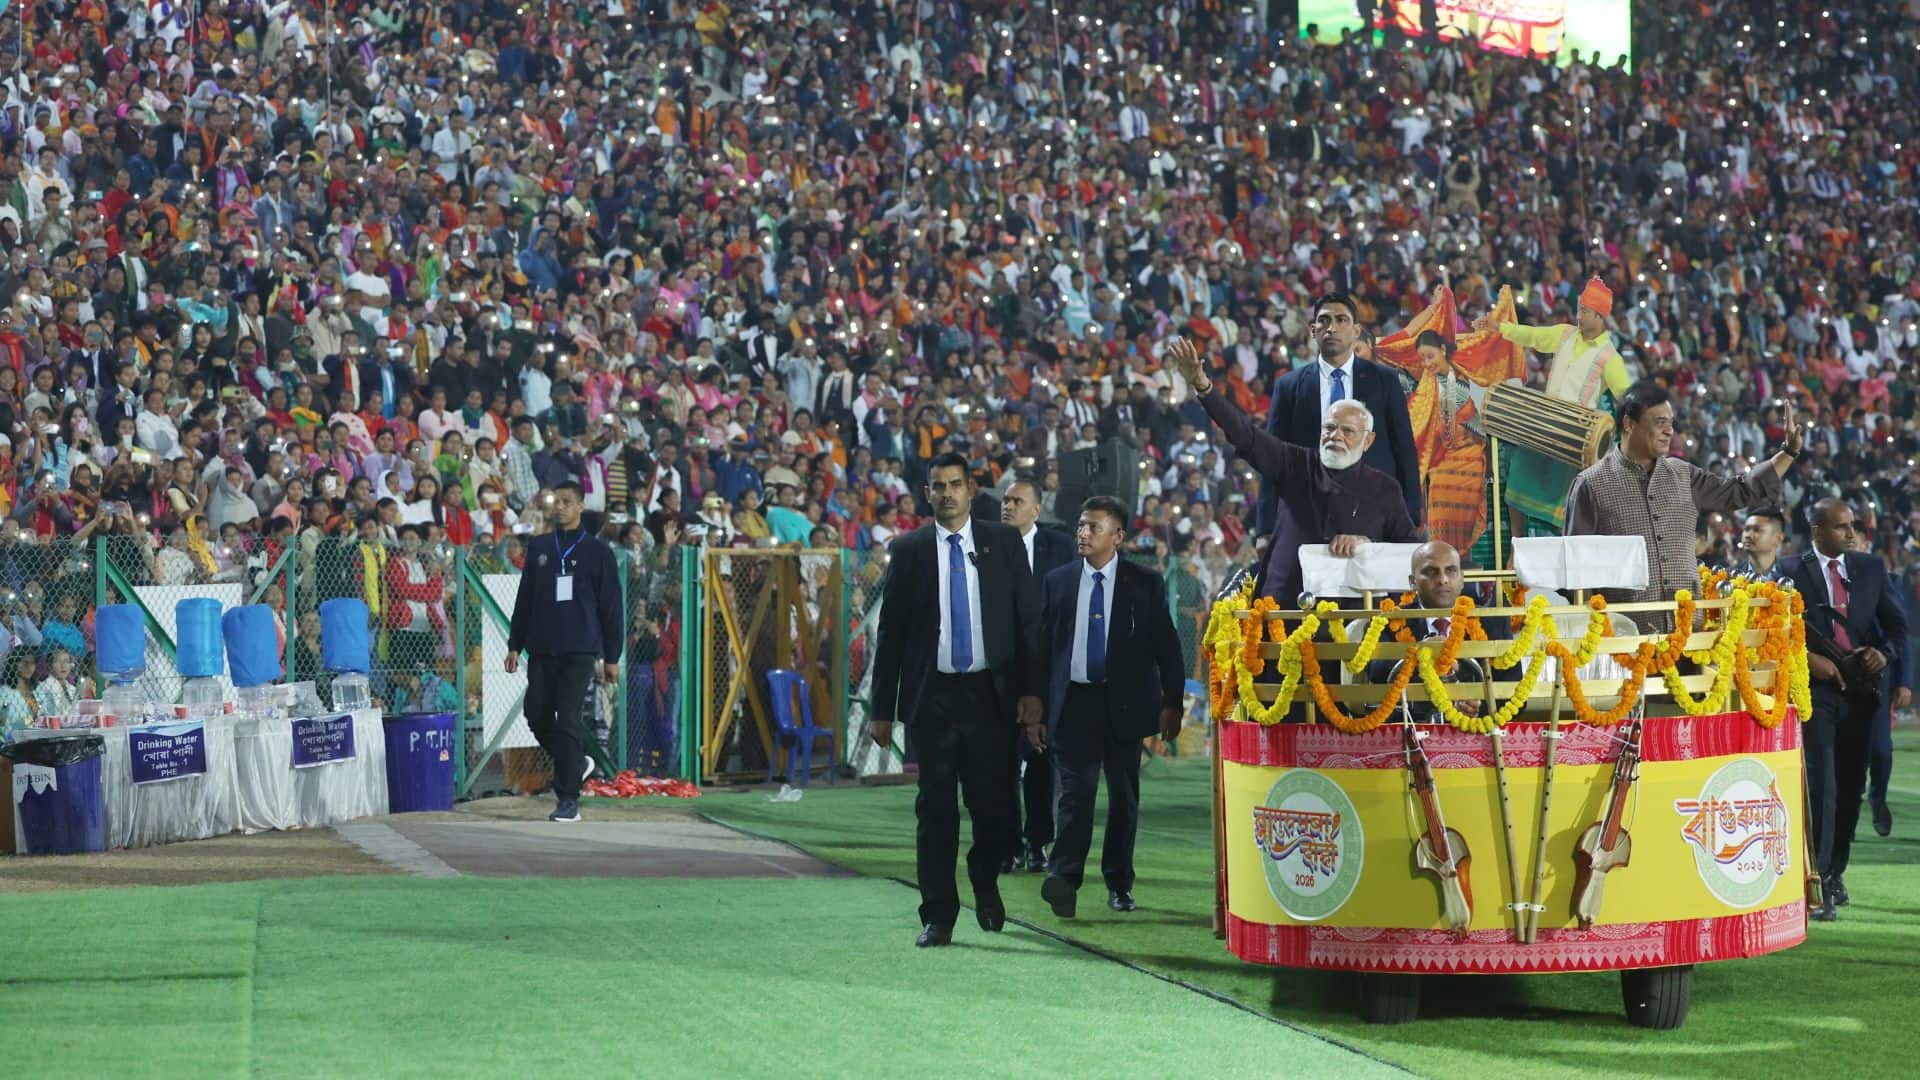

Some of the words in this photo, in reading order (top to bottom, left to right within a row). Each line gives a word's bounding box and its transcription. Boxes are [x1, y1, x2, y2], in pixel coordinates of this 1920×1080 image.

[298, 722, 326, 735] Drinking
[328, 721, 348, 730] Water
[137, 738, 172, 751] Drinking
[175, 735, 198, 746] Water
[161, 768, 177, 777] PHE
[1295, 874, 1315, 887] 2026
